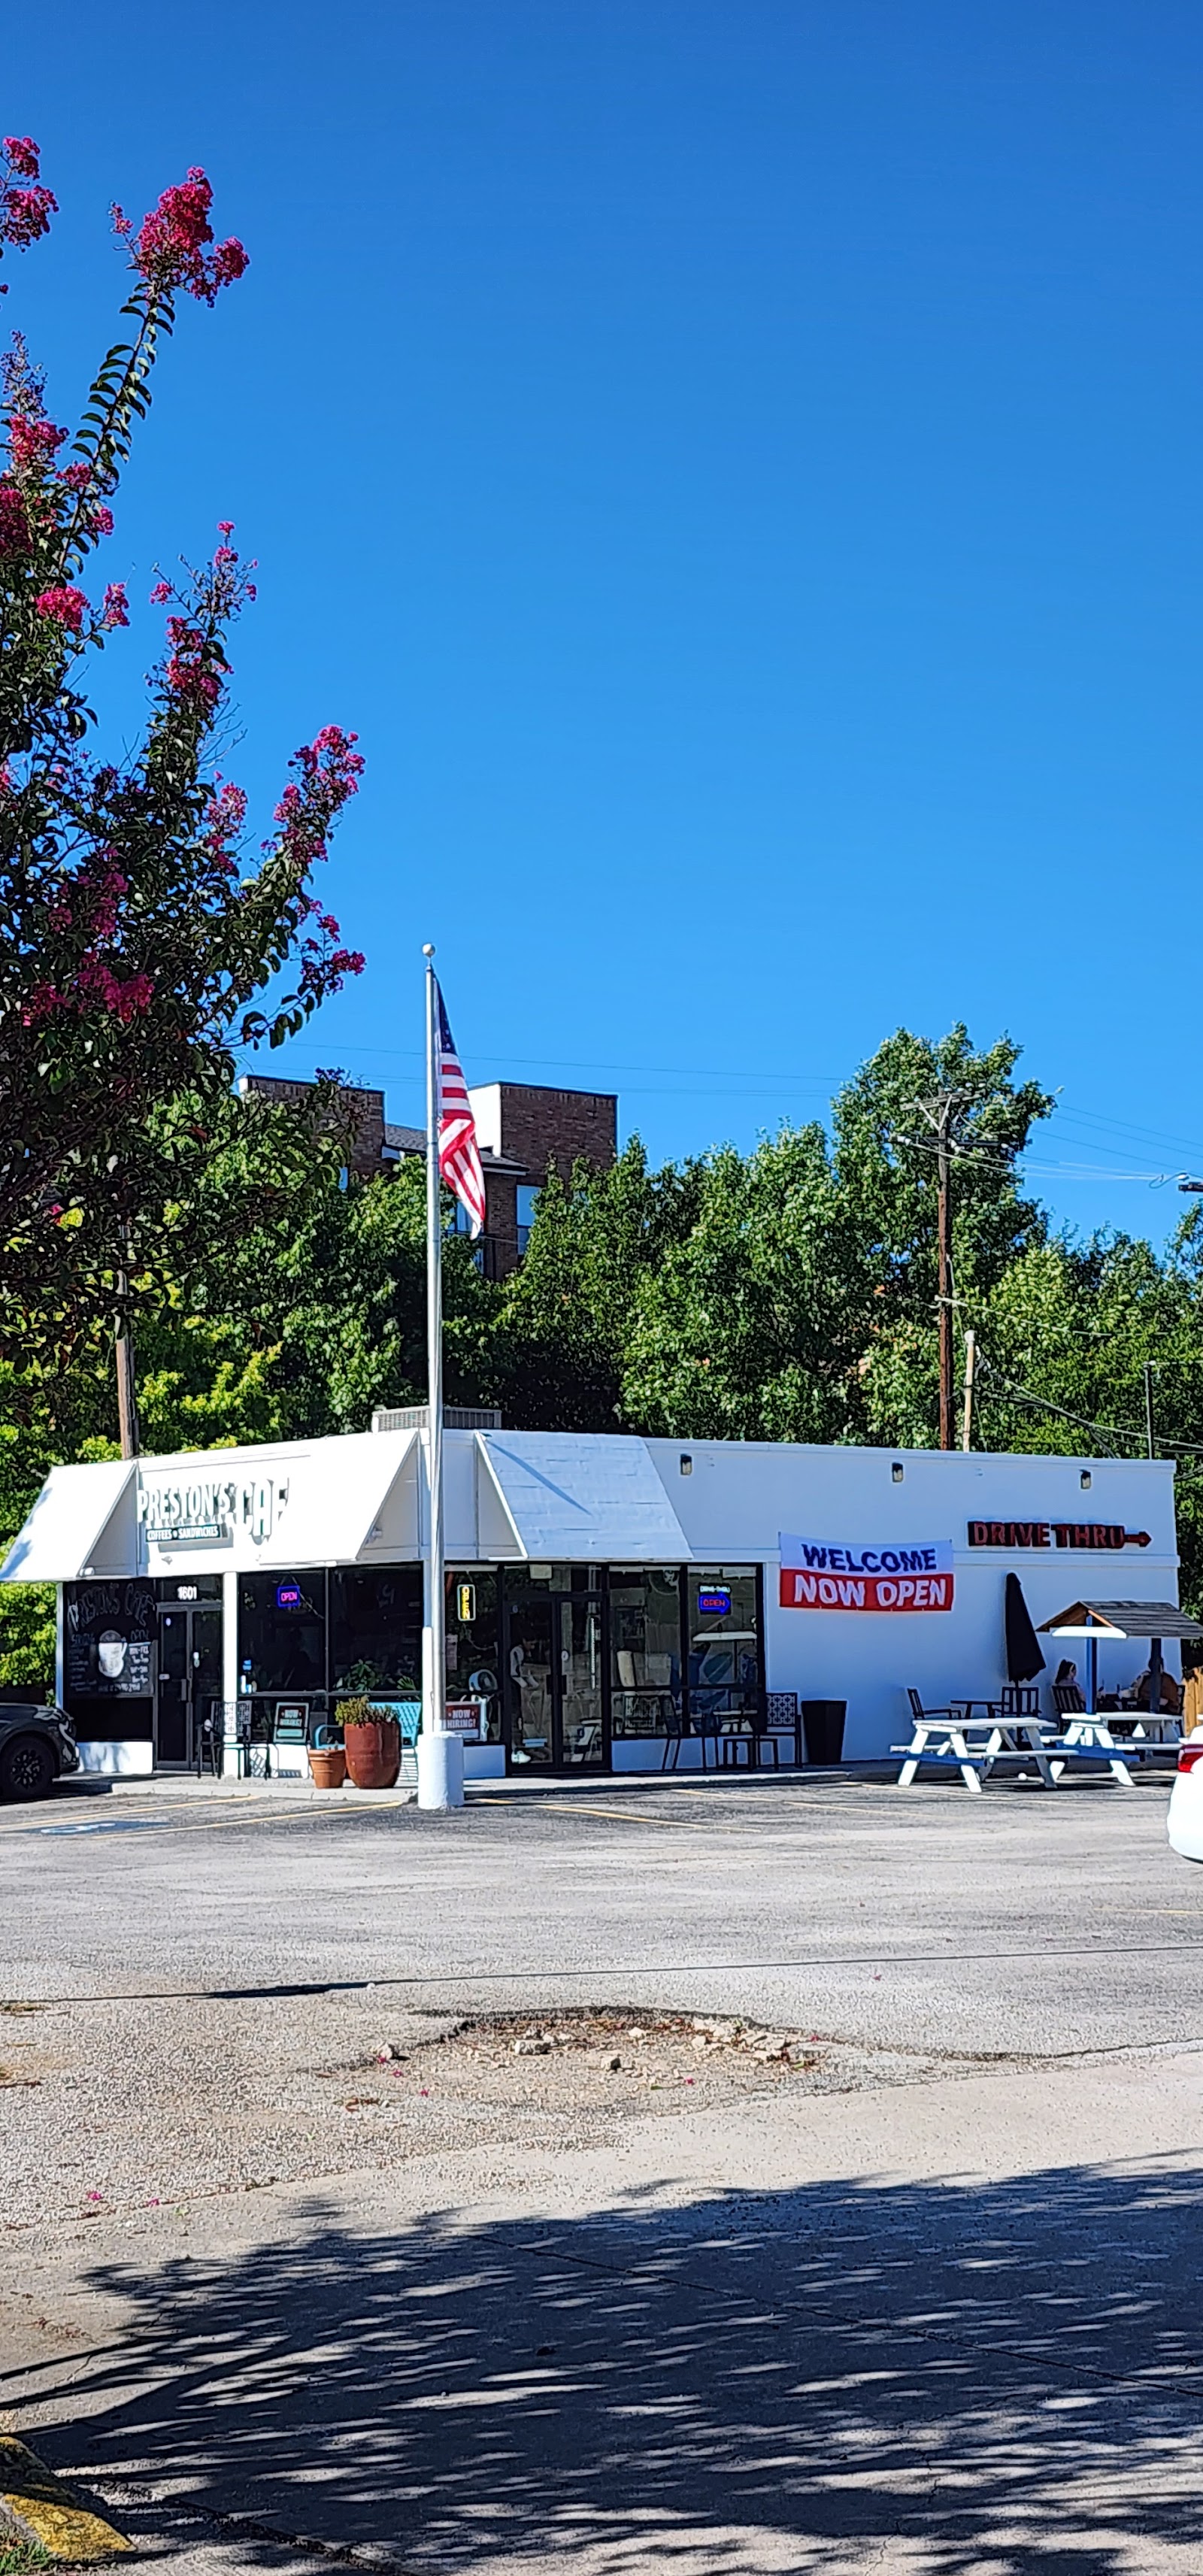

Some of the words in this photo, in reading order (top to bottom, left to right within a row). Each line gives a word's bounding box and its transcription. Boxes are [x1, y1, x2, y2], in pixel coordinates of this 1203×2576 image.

[137, 1483, 235, 1523] PRESTON'S
[147, 1529, 172, 1541] COFFEES
[178, 1526, 218, 1540] SANDWICHES
[968, 1521, 1050, 1547] DRIVE
[1051, 1523, 1125, 1549] THRU
[801, 1543, 937, 1573] WELCOME
[177, 1586, 197, 1600] 1601
[280, 1592, 298, 1602] OPEN
[794, 1574, 865, 1607] NOW
[876, 1578, 946, 1607] OPEN
[462, 1586, 471, 1620] OPEN
[703, 1599, 726, 1607] OPEN
[453, 1709, 471, 1719] NOW
[447, 1719, 476, 1729] HIRING!
